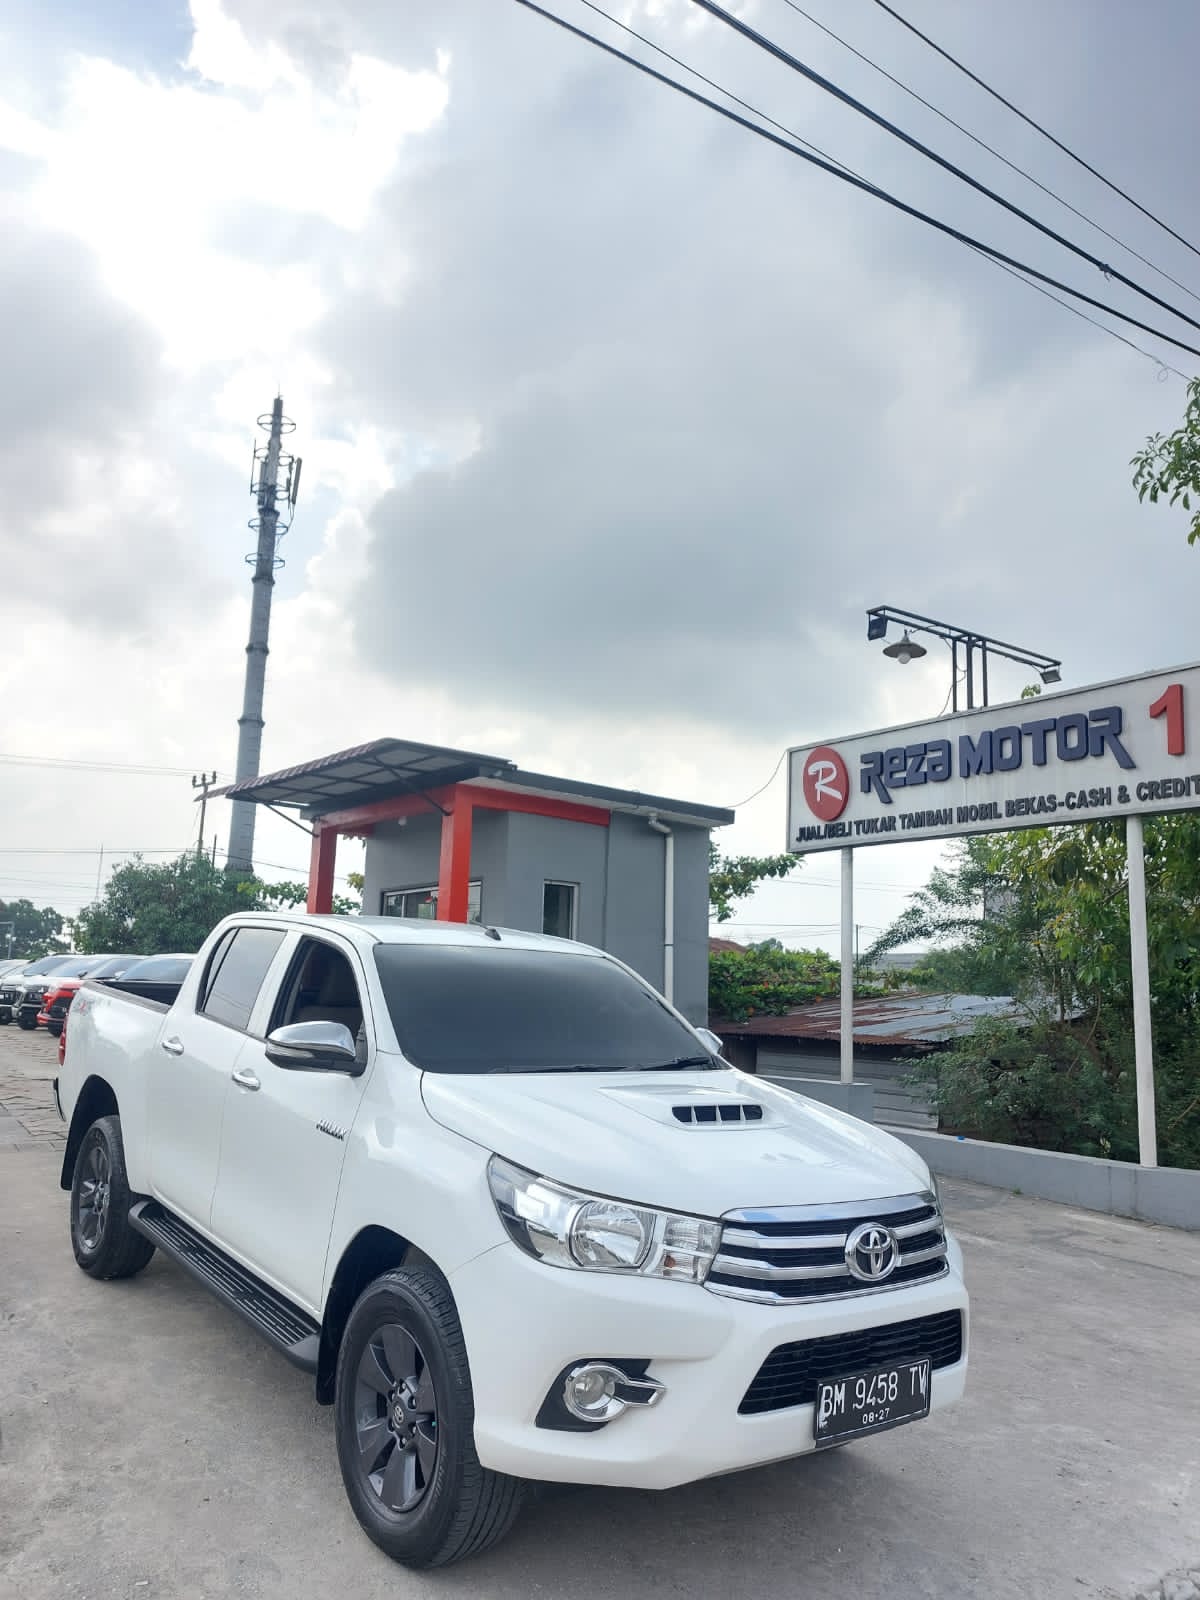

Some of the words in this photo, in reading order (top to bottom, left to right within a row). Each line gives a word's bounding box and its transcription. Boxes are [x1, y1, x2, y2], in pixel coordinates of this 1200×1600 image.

[959, 705, 1136, 778] MOTOR
[1149, 683, 1184, 756] 1
[854, 816, 897, 836] TUKAR
[899, 808, 953, 830] TAMBAH
[957, 801, 1002, 824] MOBIL
[1118, 785, 1130, 804] &
[822, 1383, 845, 1417] BM
[854, 1371, 898, 1409] 9458
